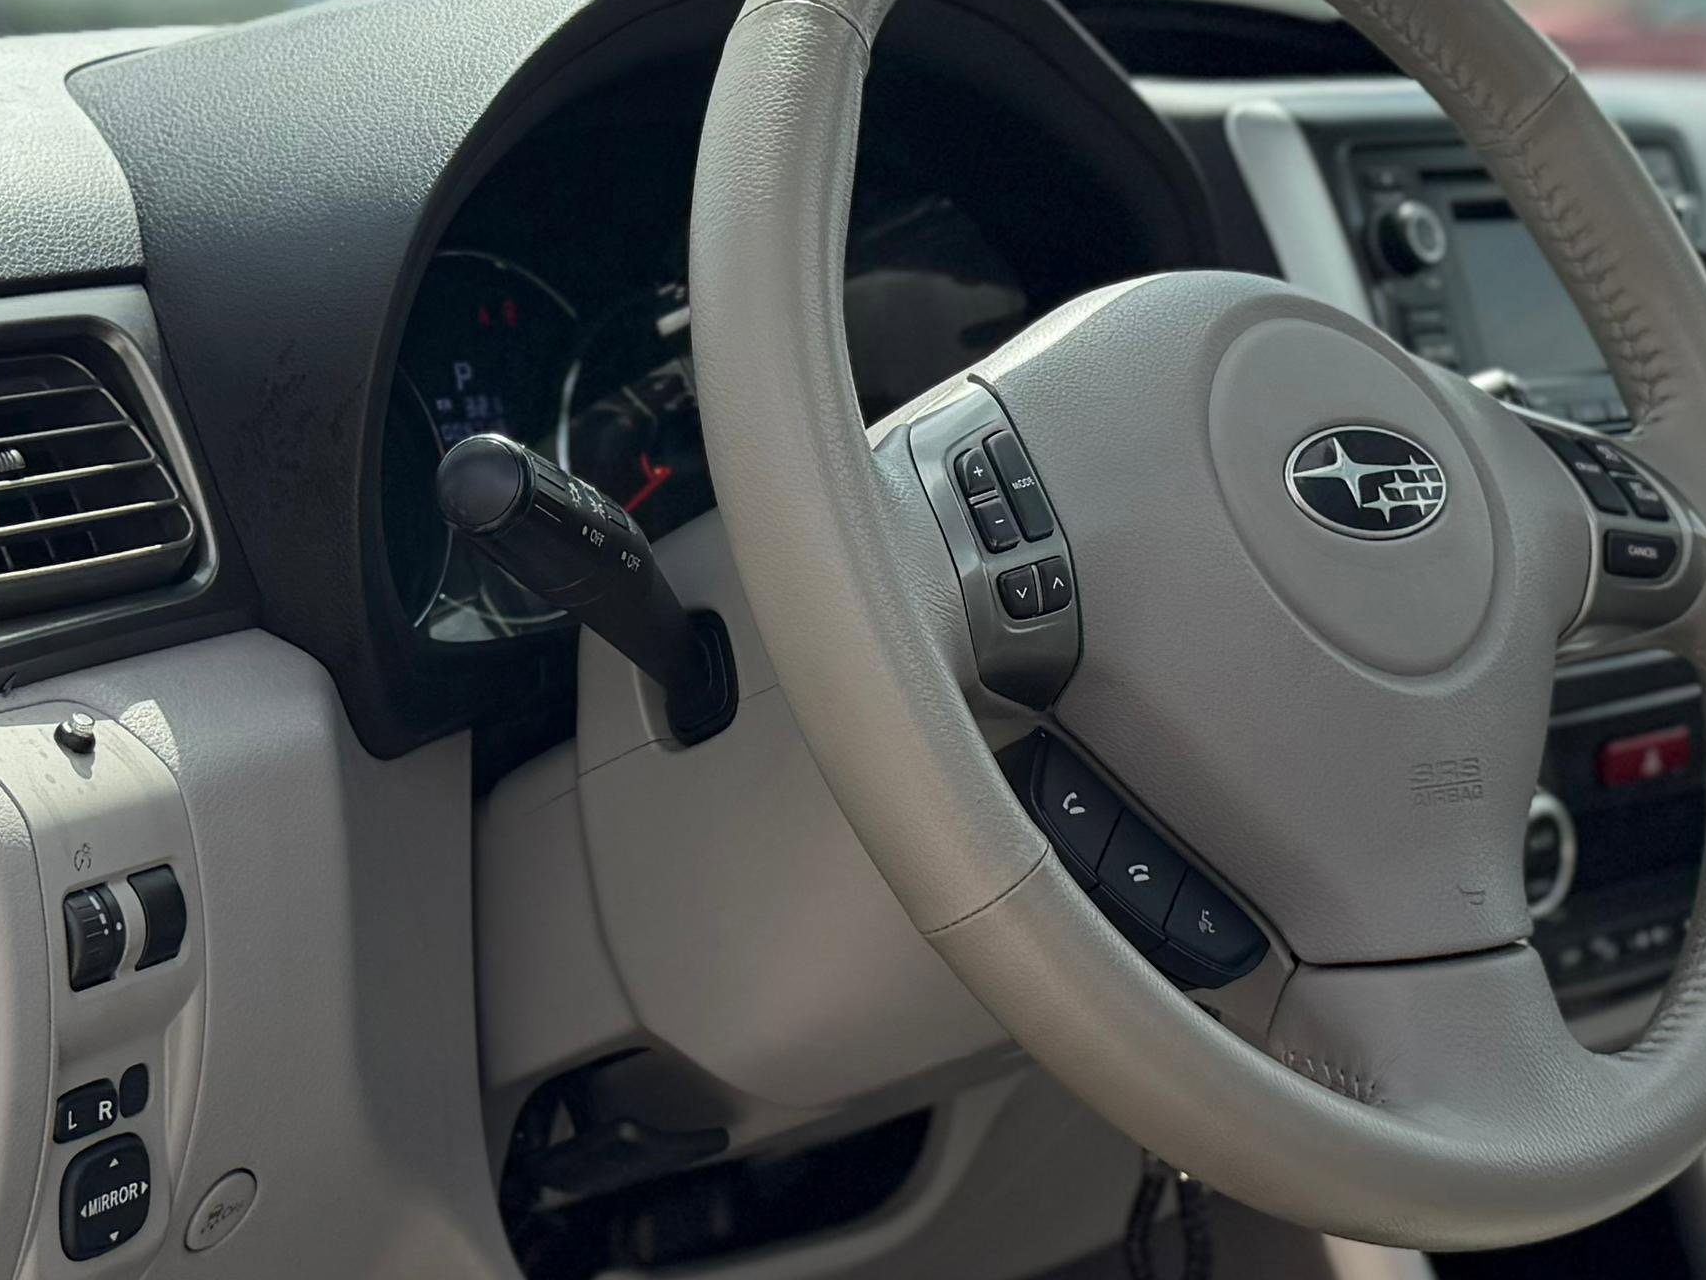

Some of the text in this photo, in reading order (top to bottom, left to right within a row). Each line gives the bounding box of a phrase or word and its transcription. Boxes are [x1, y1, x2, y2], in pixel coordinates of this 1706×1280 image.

[454, 361, 473, 391] P
[1011, 476, 1035, 490] MODE
[1408, 757, 1481, 783] SRS
[1412, 784, 1485, 807] AIRBAG
[67, 1100, 114, 1130] L R
[87, 1181, 139, 1218] MIRROR
